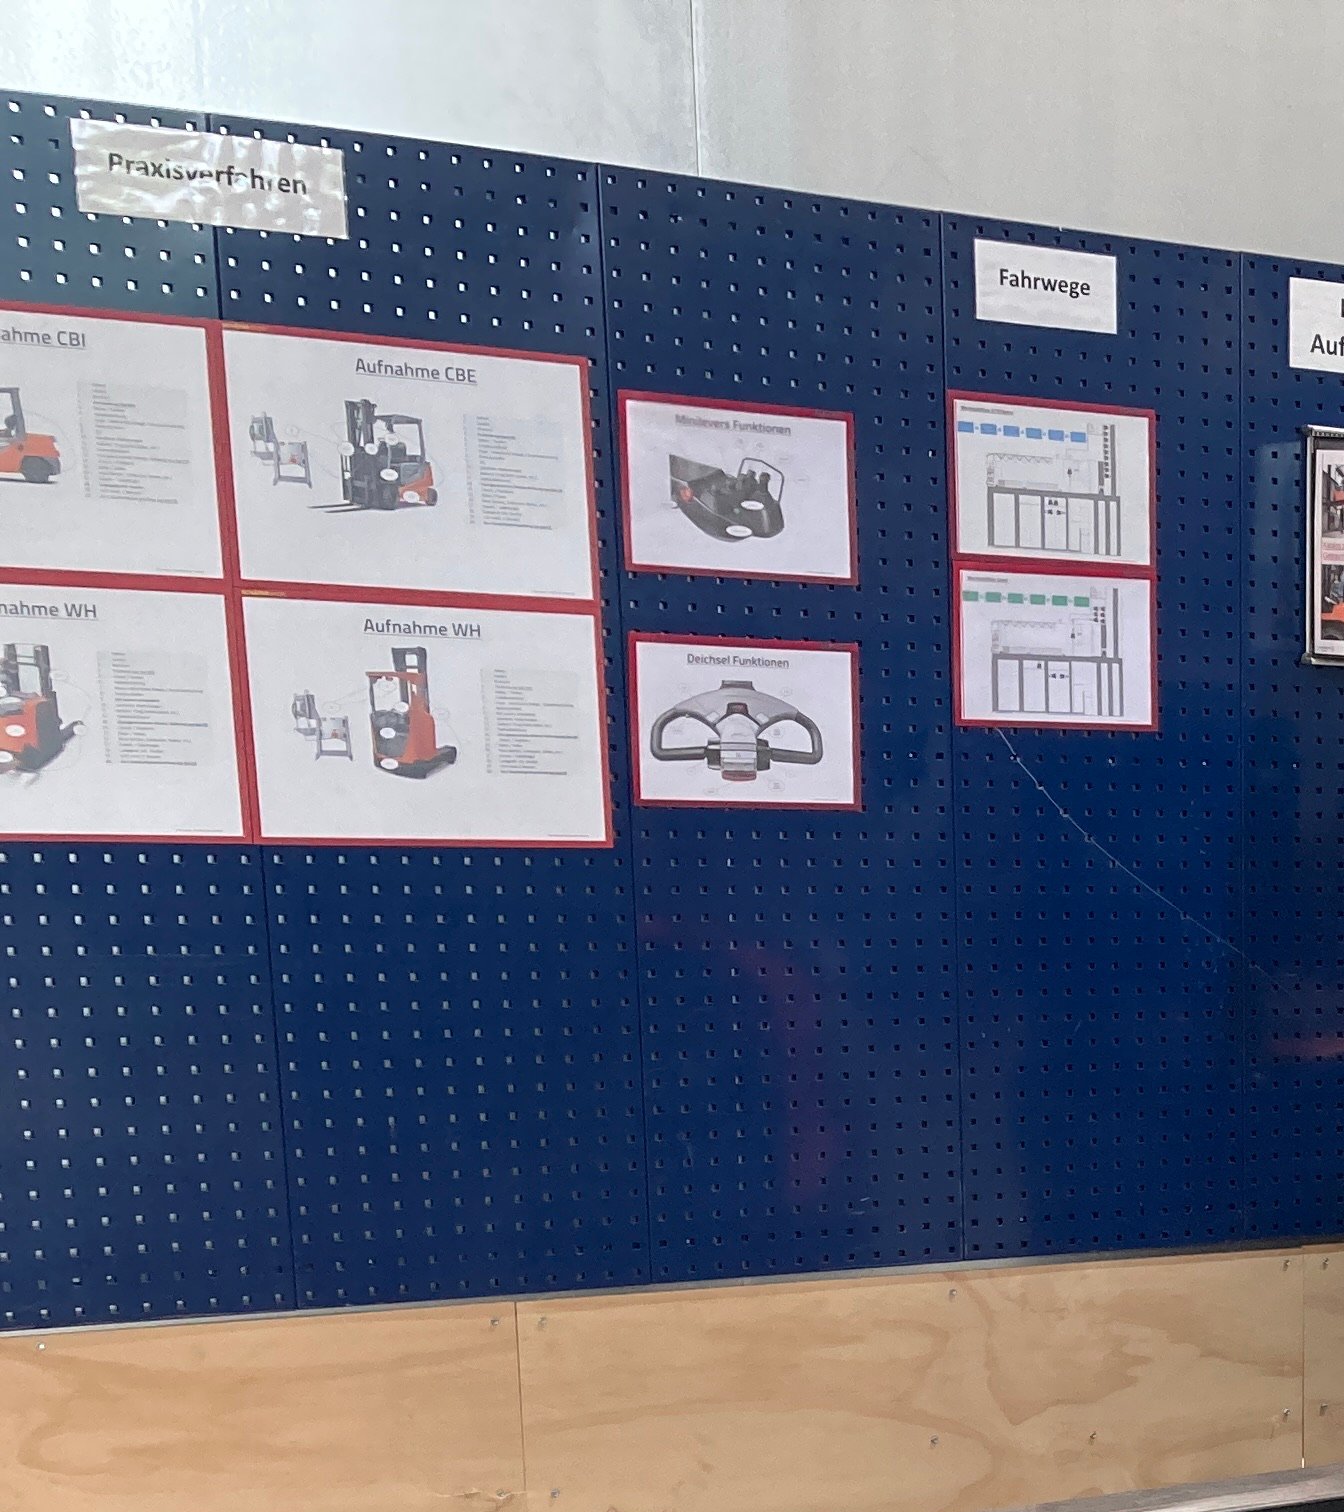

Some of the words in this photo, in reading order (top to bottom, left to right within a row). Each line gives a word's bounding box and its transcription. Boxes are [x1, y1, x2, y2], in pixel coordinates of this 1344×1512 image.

[107, 152, 308, 196] Praxisverfhren
[999, 268, 1091, 298] Fahrwege
[57, 331, 86, 347] CBI
[355, 357, 440, 382] Aufnahme
[445, 366, 477, 384] CBE
[732, 420, 791, 435] Funktionen
[64, 602, 97, 618] WH
[363, 617, 448, 637] Aufnahme
[452, 621, 481, 639] WH
[687, 653, 730, 667] Deichsel
[732, 655, 790, 669] Funktionen
